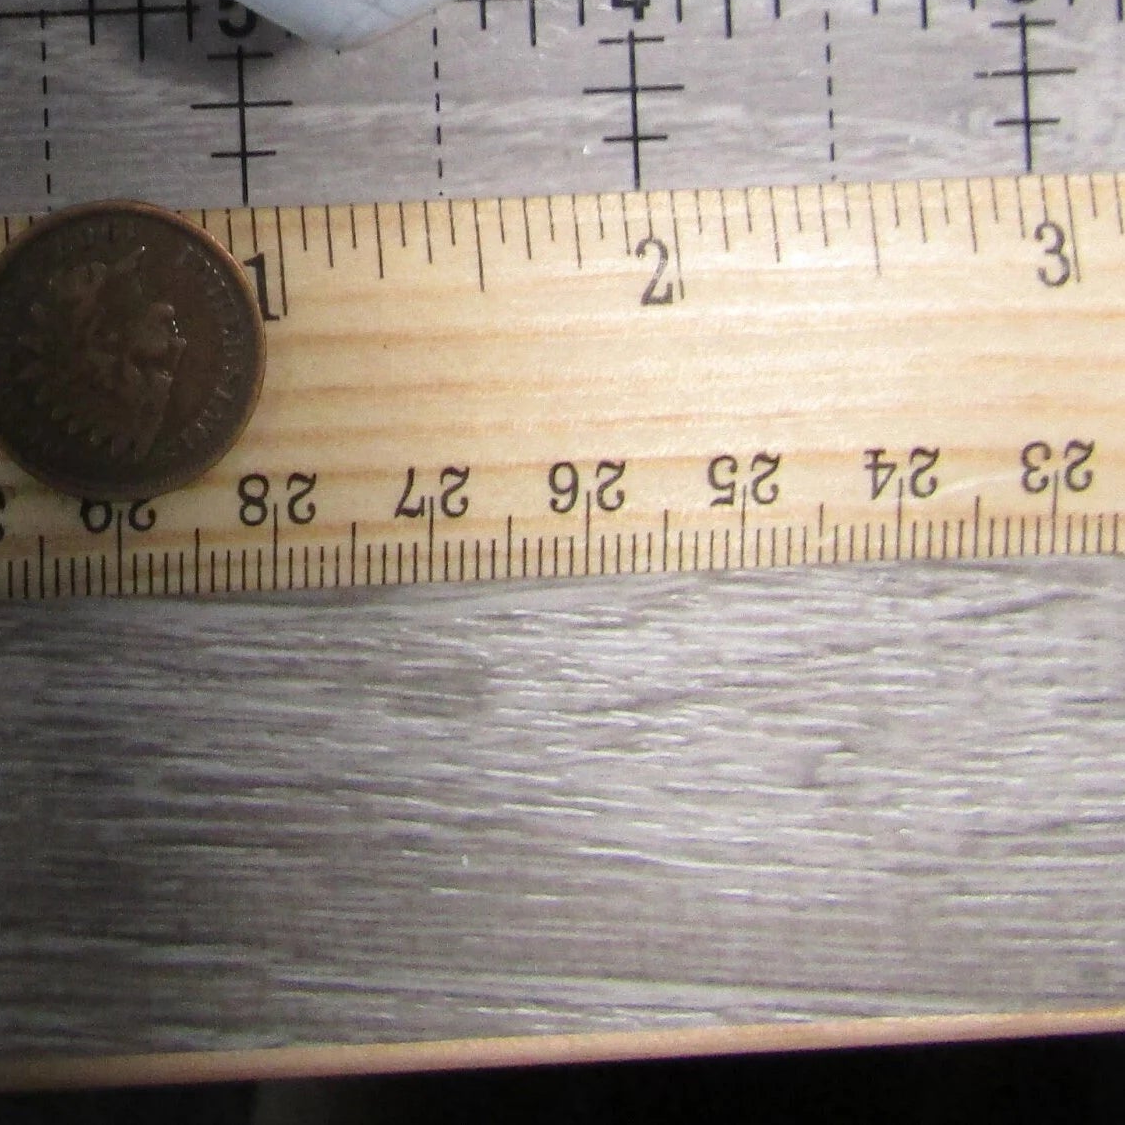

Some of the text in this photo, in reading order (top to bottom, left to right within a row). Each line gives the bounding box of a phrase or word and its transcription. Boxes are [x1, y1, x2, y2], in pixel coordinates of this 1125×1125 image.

[635, 237, 675, 306] 2
[1034, 221, 1071, 287] 3
[242, 250, 280, 321] 1
[393, 465, 470, 518] 27
[548, 460, 627, 513] 26
[707, 452, 782, 506] 25
[864, 446, 941, 500] 24
[1020, 440, 1095, 493] 23
[237, 472, 317, 526] 28
